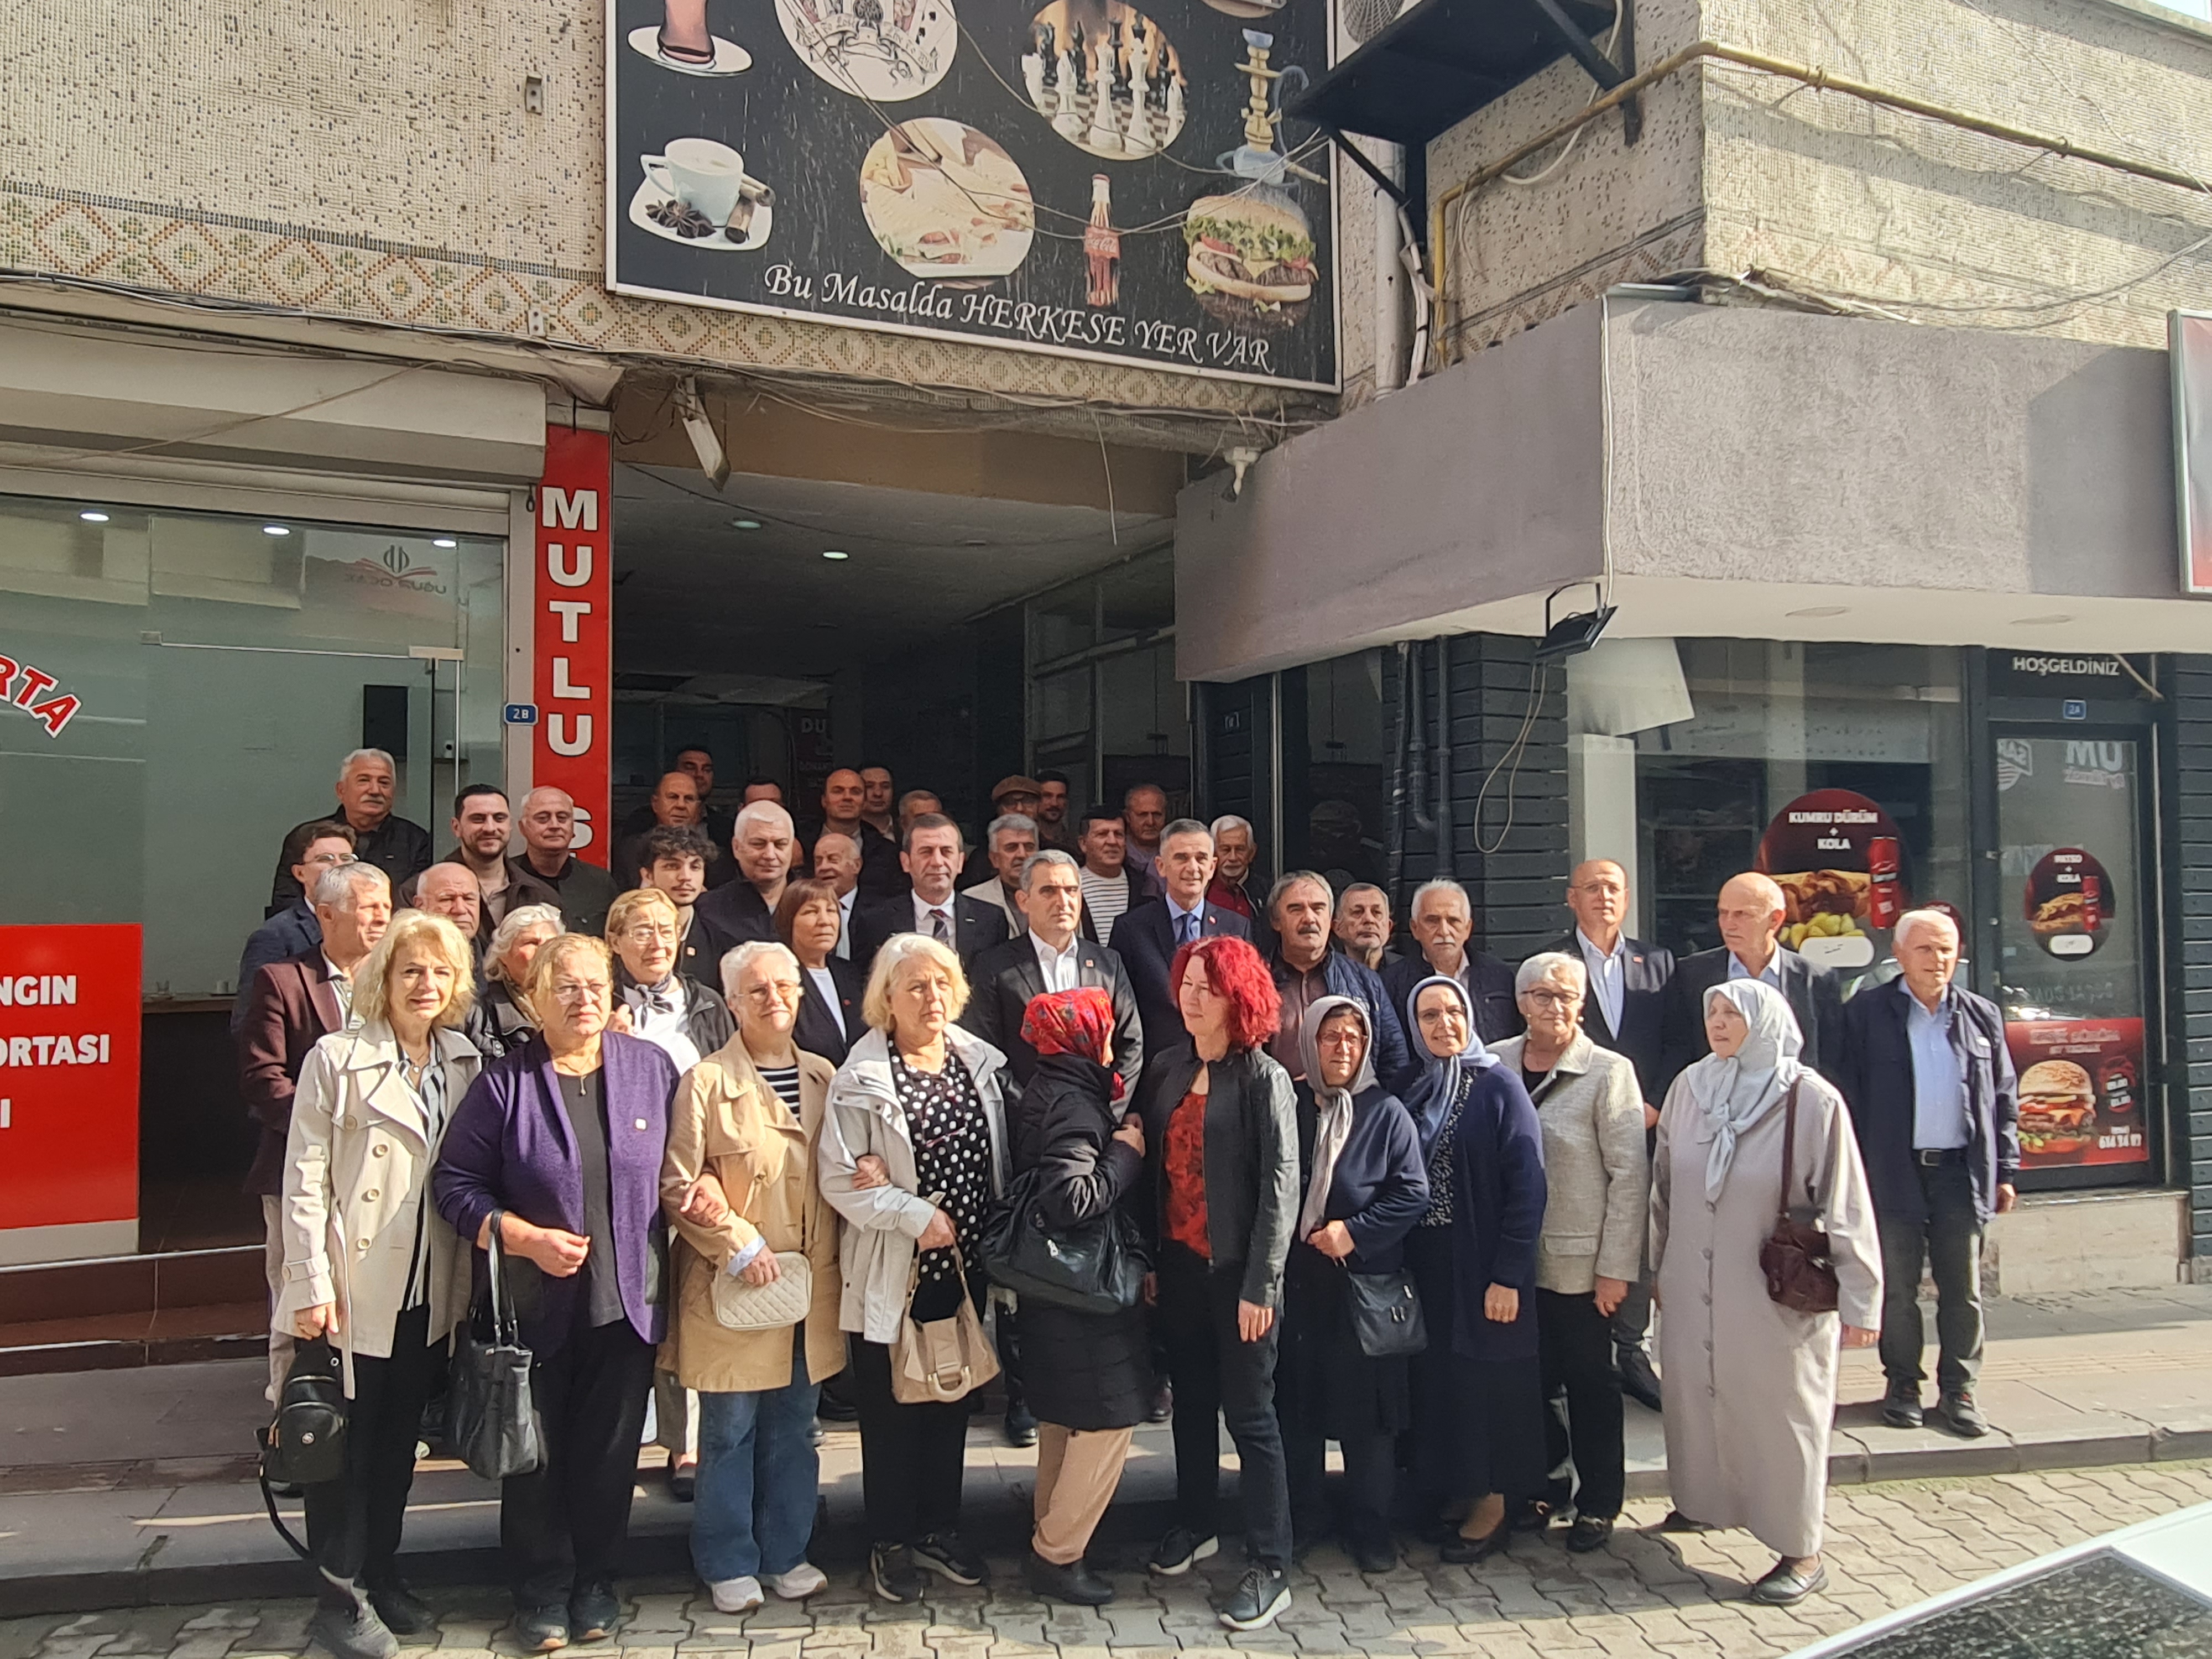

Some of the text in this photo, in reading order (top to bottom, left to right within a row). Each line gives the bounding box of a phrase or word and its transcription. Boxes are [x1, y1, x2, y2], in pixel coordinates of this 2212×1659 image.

[764, 264, 1276, 375] Bu Masalda HERKESE YER VAR
[541, 486, 598, 757] MUTLU
[2012, 656, 2120, 676] HOŞGELDİNİZ
[513, 708, 530, 720] 2B
[1789, 808, 1878, 823] KUMRU DÜRÜM
[1817, 838, 1851, 850] KOLA
[0, 1034, 110, 1067] RTASI
